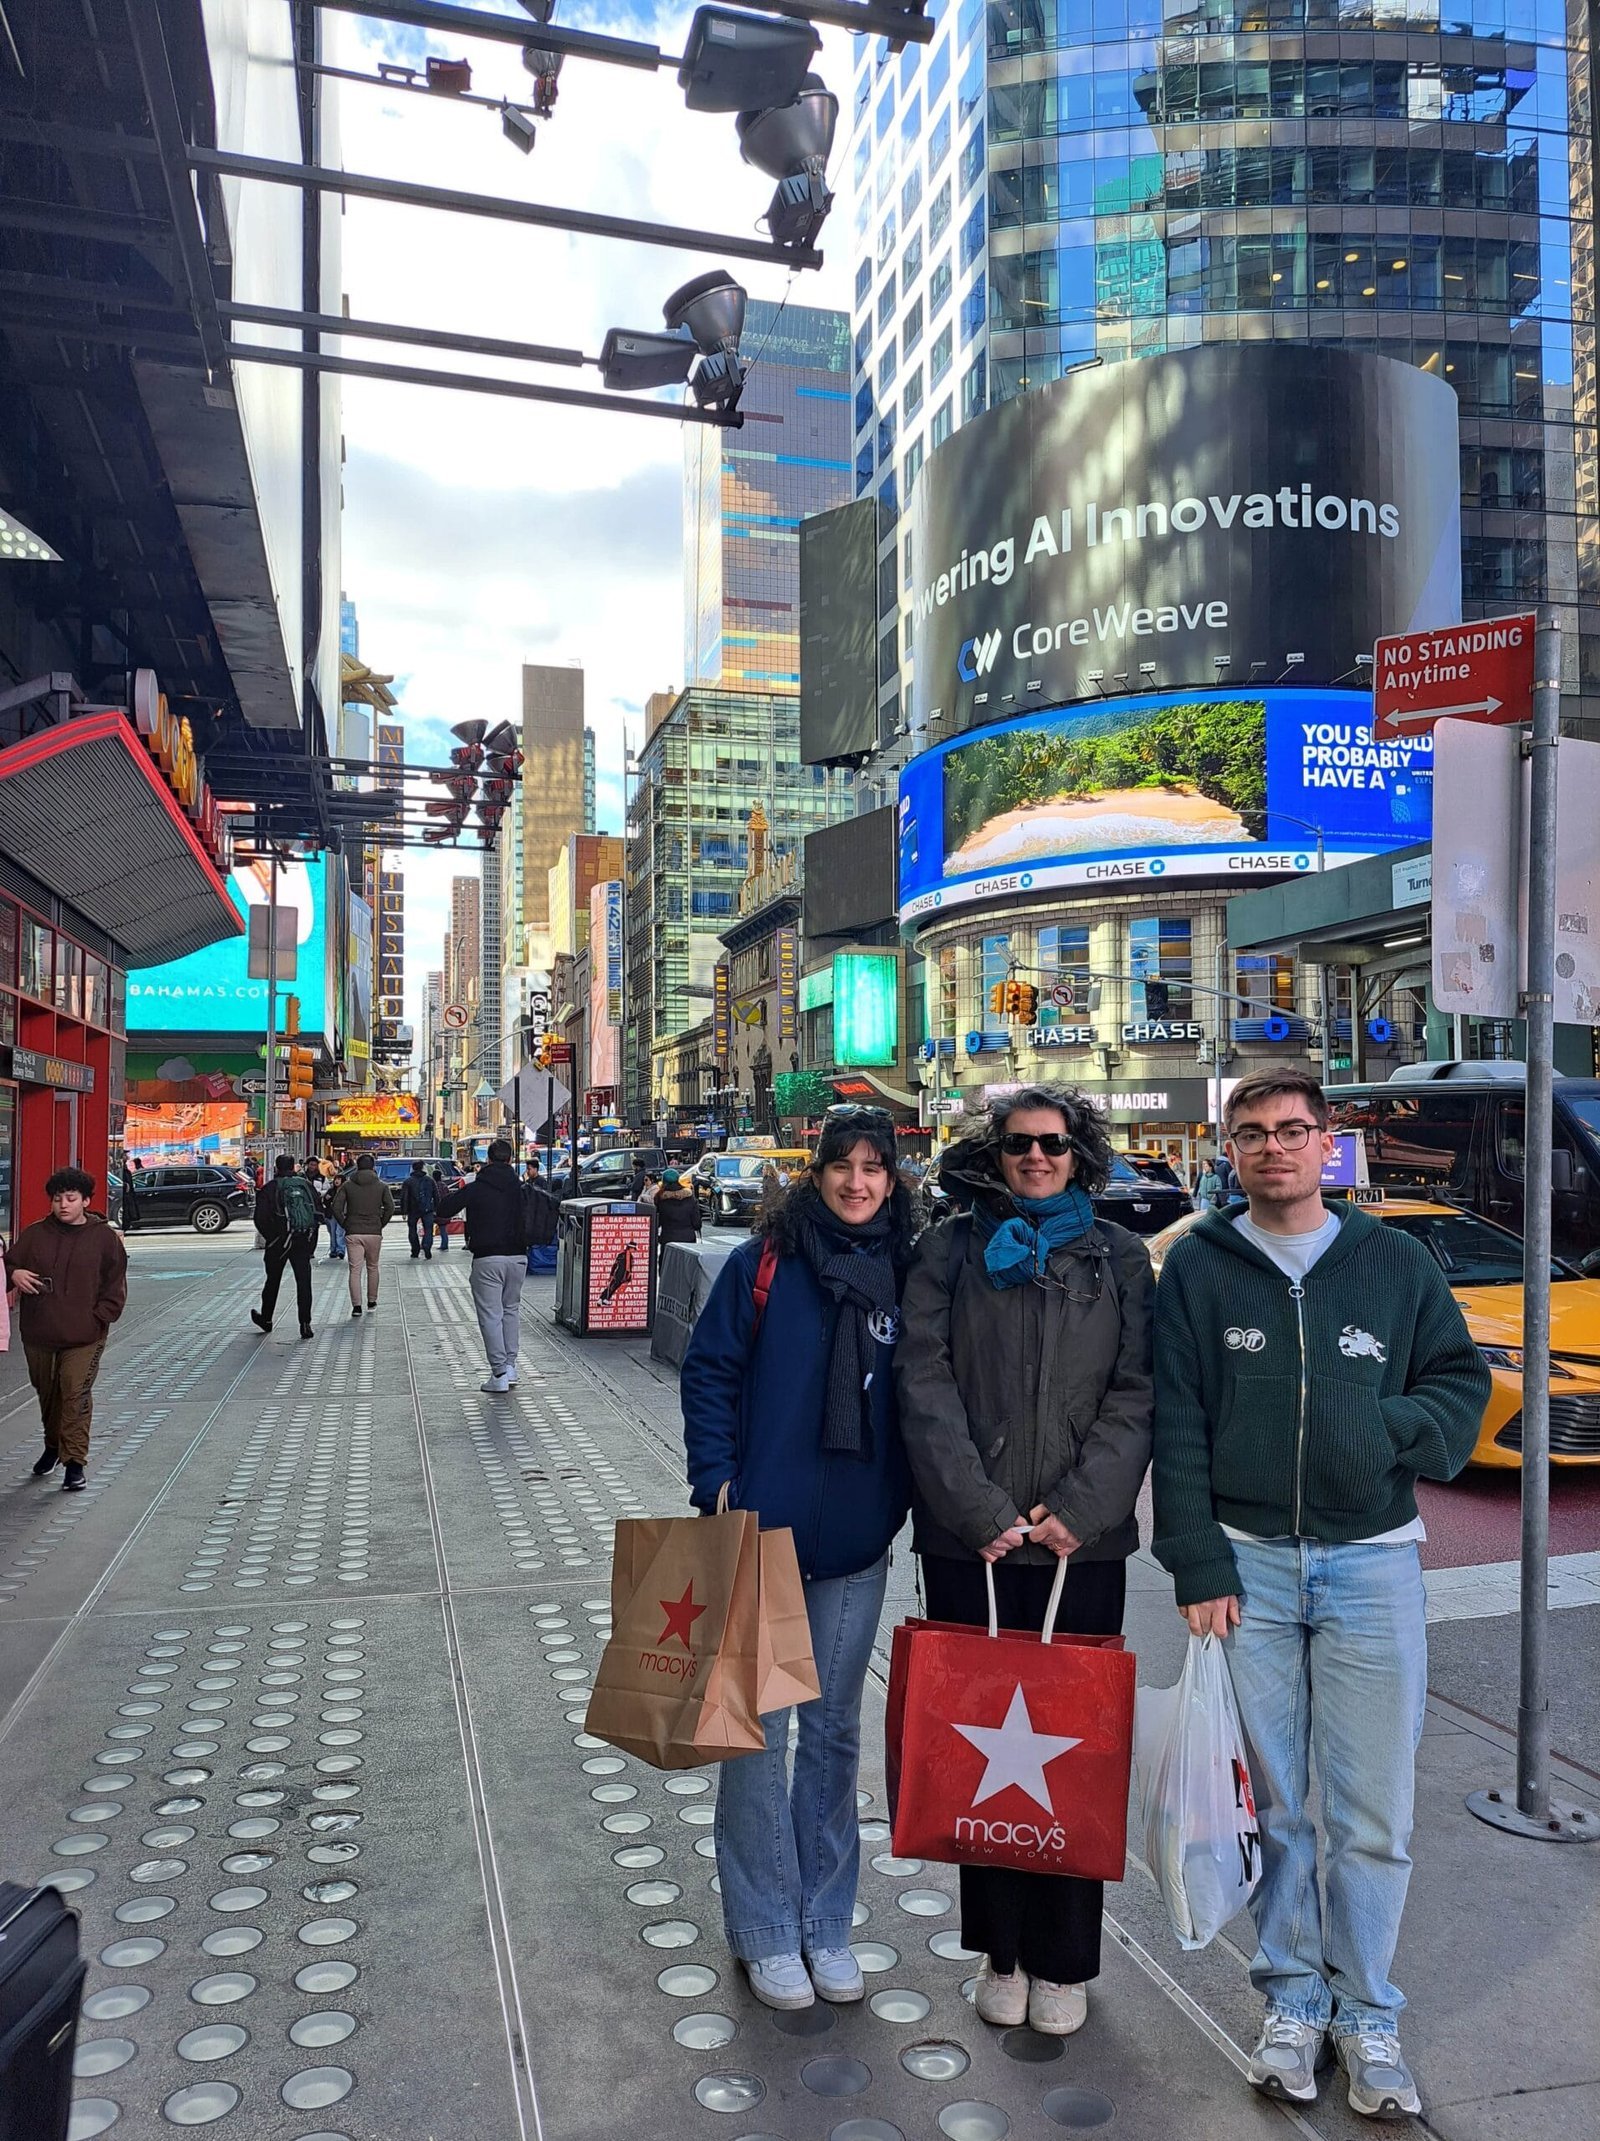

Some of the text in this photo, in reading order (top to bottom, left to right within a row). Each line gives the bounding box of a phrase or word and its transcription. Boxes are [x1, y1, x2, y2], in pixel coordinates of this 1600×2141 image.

[1023, 508, 1072, 565] AI
[1086, 482, 1400, 548] Innovations
[1012, 600, 1229, 661] CoreWeave
[1384, 626, 1523, 667] NO STANDING
[1383, 663, 1471, 690] Anytime
[1302, 723, 1433, 752] YOU SULD
[1302, 745, 1411, 769] PROBABLY
[1302, 767, 1386, 790] HAVE A
[1086, 861, 1145, 878] CHASE
[1229, 855, 1291, 869] CHASE
[608, 883, 620, 905] NEW
[974, 876, 1018, 895] CHASE
[911, 895, 933, 913] CHASE
[608, 907, 620, 930] 42
[608, 945, 621, 987] STUDIOS
[781, 931, 794, 1035] NEW VICTORY
[715, 967, 728, 1054] NEW VICTORY
[1026, 1026, 1092, 1044] CHASE
[1121, 1022, 1200, 1041] CHASE
[1112, 1093, 1168, 1110] MADDEN
[1356, 1191, 1379, 1203] 2K71
[955, 1843, 1063, 1864] NEW YORK
